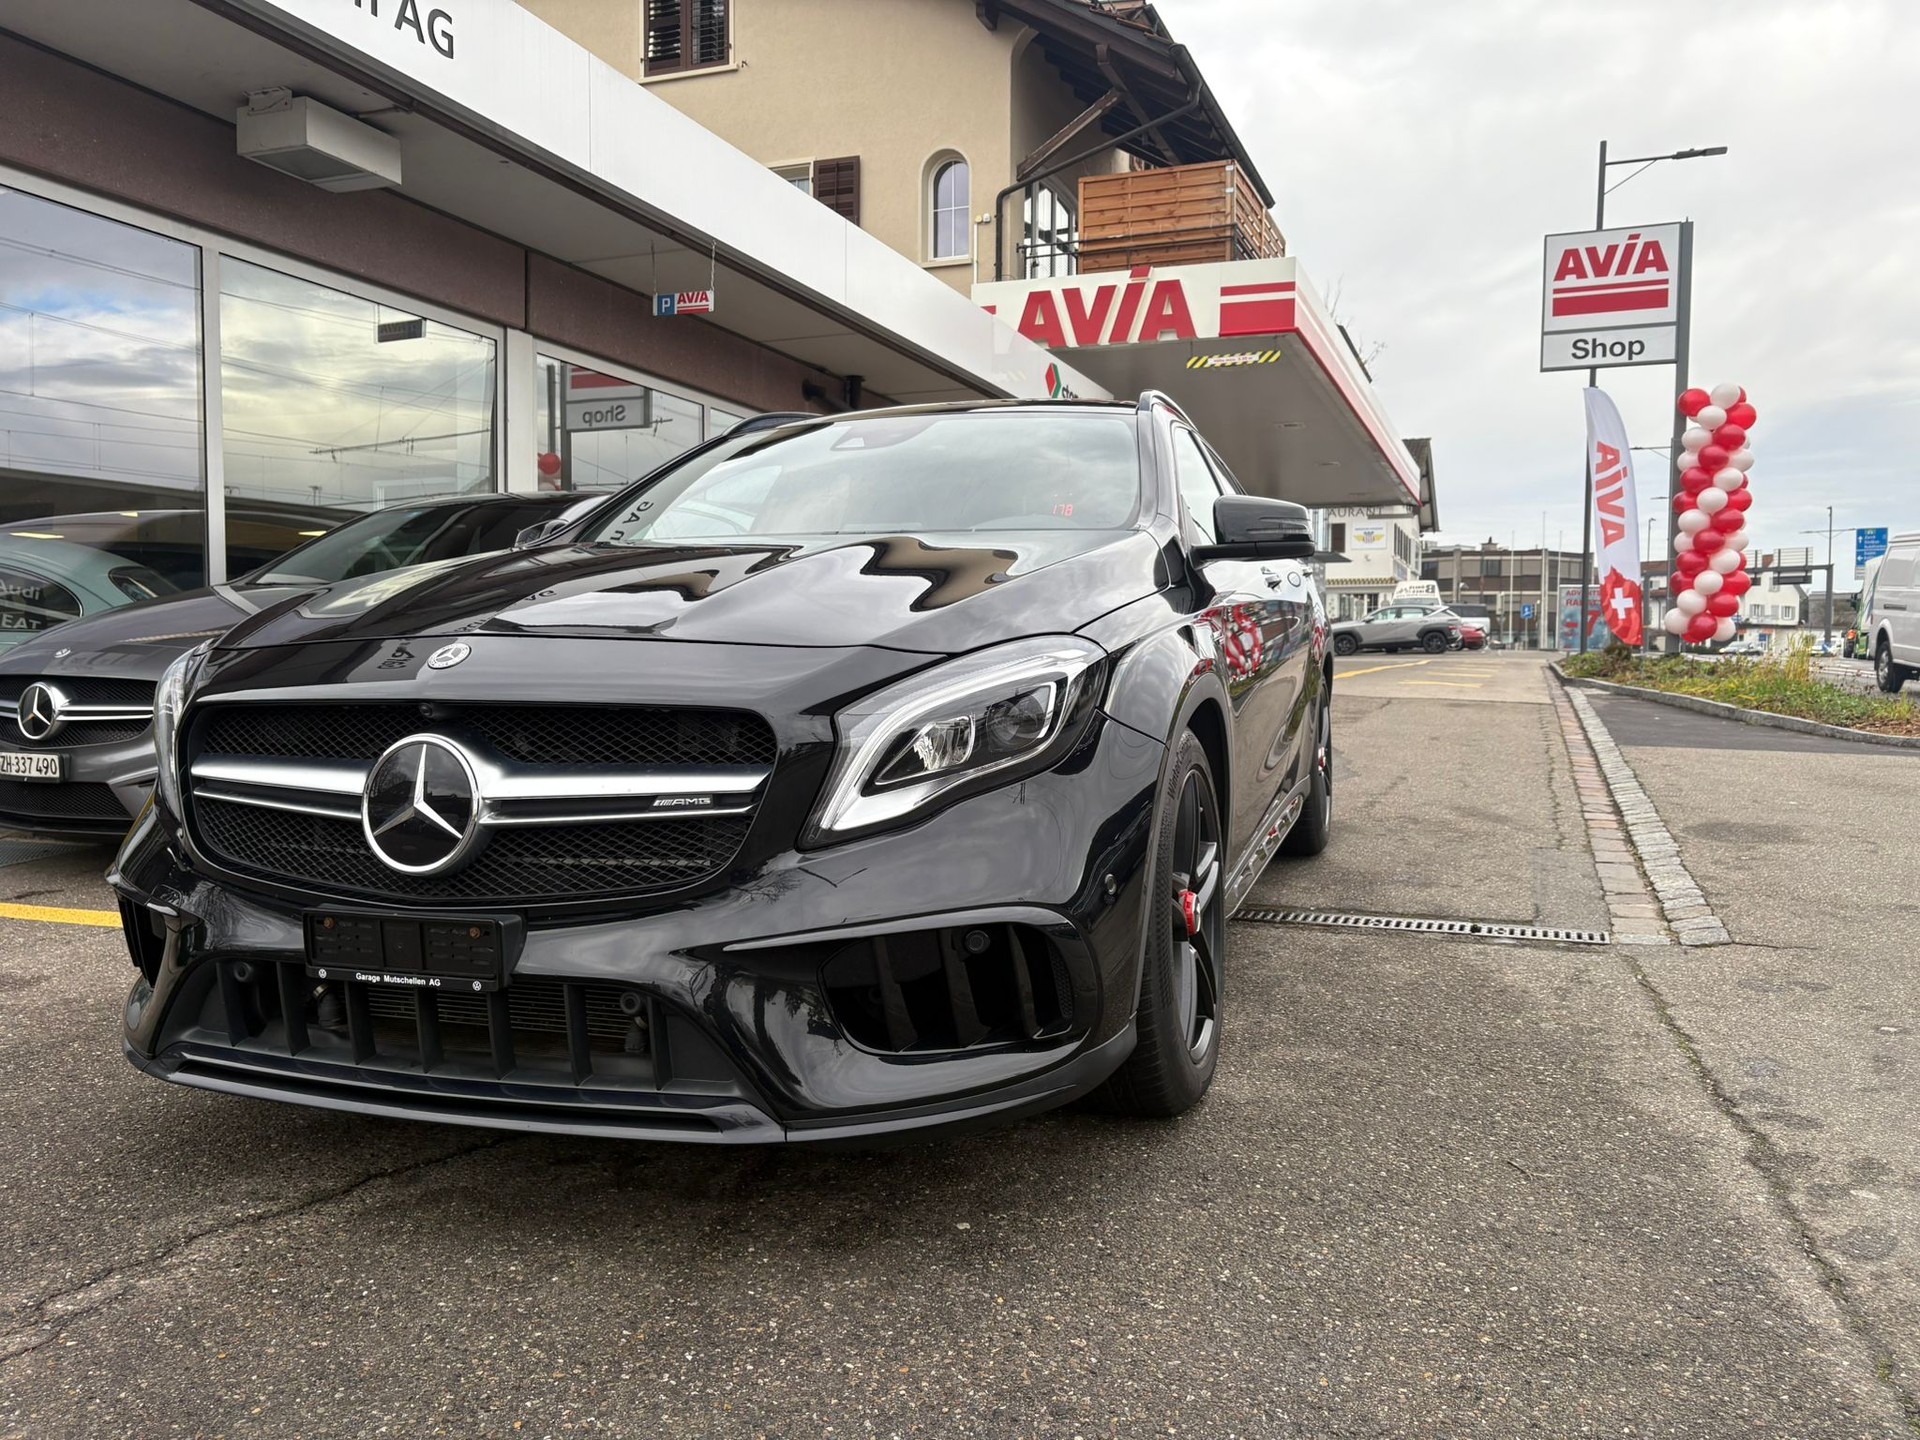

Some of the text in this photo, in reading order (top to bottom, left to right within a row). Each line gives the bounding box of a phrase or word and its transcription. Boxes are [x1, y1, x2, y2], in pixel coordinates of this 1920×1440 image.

[394, 0, 454, 59] AG
[662, 291, 709, 313] P AVIA
[1571, 338, 1646, 361] Shop
[355, 972, 381, 983] Garage
[428, 978, 441, 987] AG
